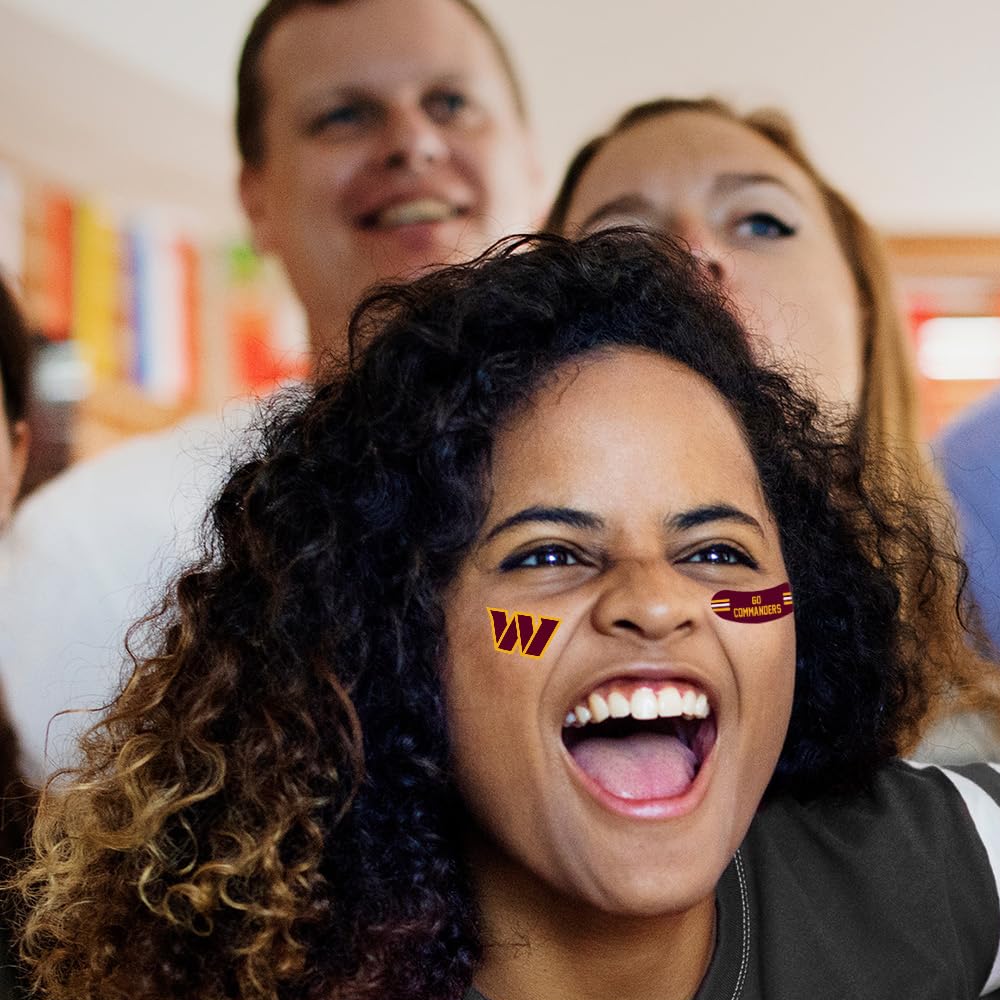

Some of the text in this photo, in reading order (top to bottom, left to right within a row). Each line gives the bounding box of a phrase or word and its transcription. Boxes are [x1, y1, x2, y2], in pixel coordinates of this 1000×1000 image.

[752, 596, 762, 605] GO
[734, 604, 782, 618] COMMANDERS
[487, 607, 562, 659] W
